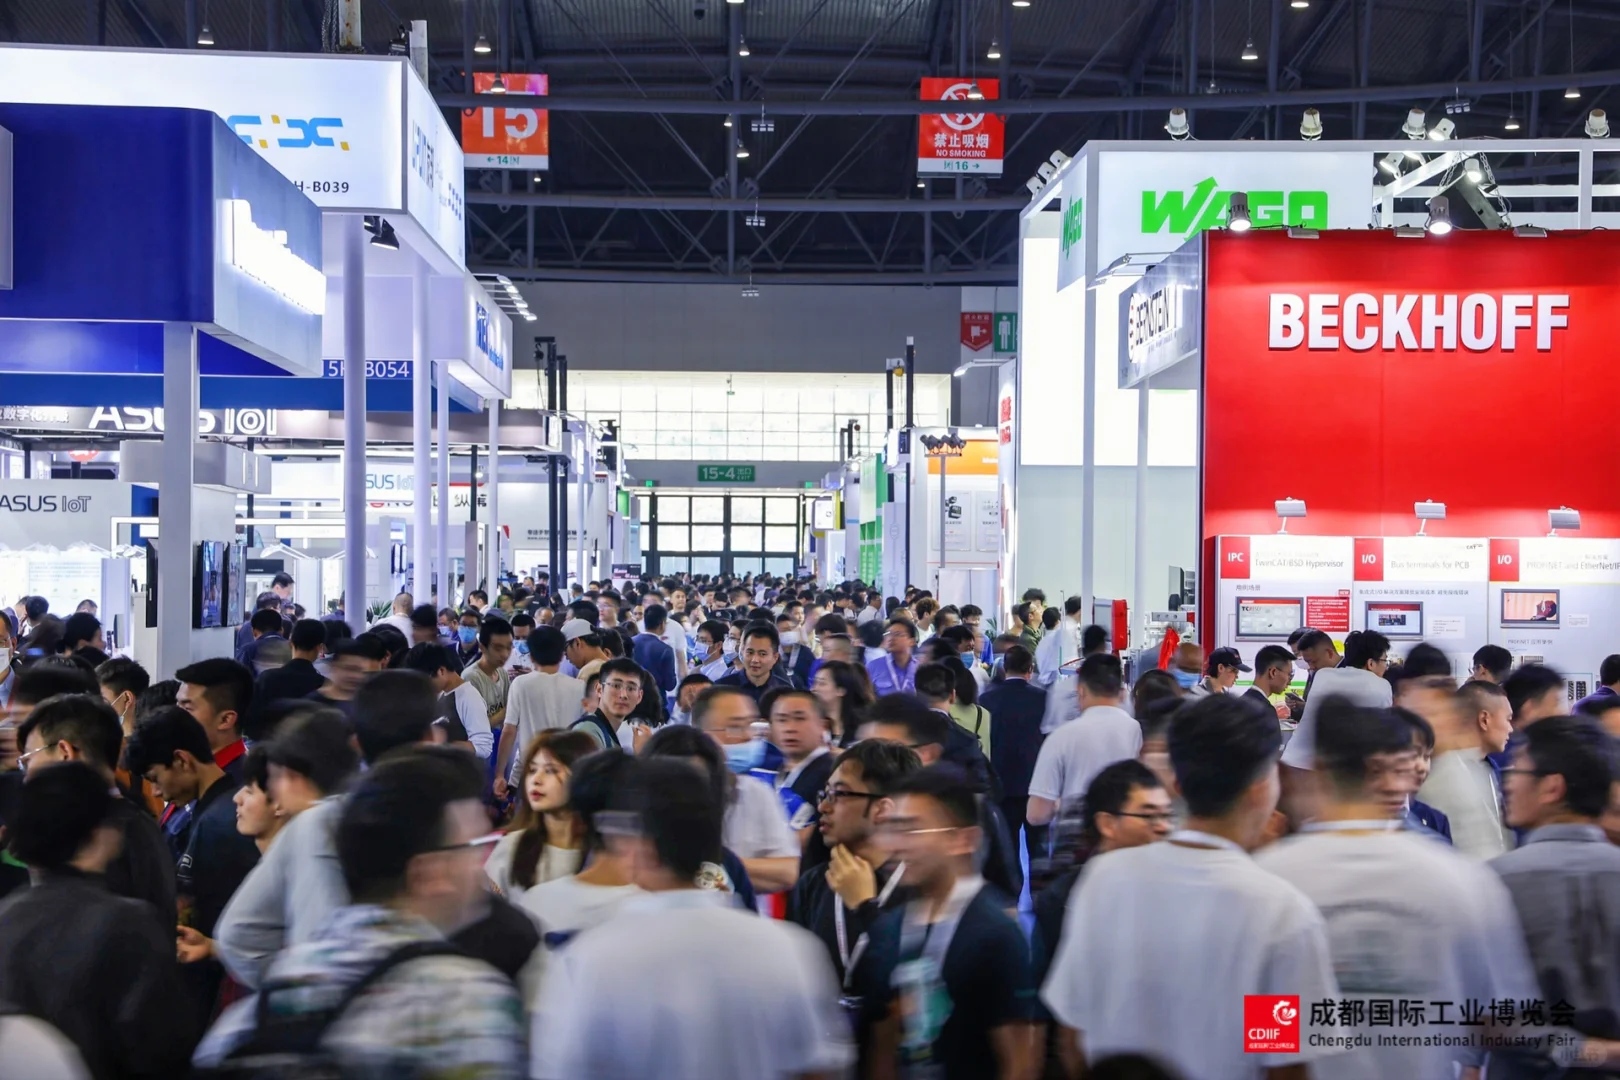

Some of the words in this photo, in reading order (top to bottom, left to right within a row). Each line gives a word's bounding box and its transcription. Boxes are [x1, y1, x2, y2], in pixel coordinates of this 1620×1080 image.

[934, 133, 989, 149] 禁止吸烟
[936, 149, 948, 157] NO
[949, 149, 986, 157] SMOKING
[1141, 177, 1328, 241] WAGO
[1062, 195, 1082, 260] WAGO
[1268, 293, 1570, 351] BECKHOFF
[702, 467, 736, 480] 15-4
[0, 495, 57, 512] ASUS
[62, 495, 92, 513] IoT
[1227, 552, 1244, 562] IPC
[1361, 554, 1376, 564] I/O
[1497, 554, 1512, 564] I/O
[1305, 559, 1344, 569] Hypervisor
[1390, 561, 1405, 569] Bus
[1406, 561, 1440, 569] terminals
[1442, 560, 1452, 569] for
[1454, 561, 1470, 569] PCB
